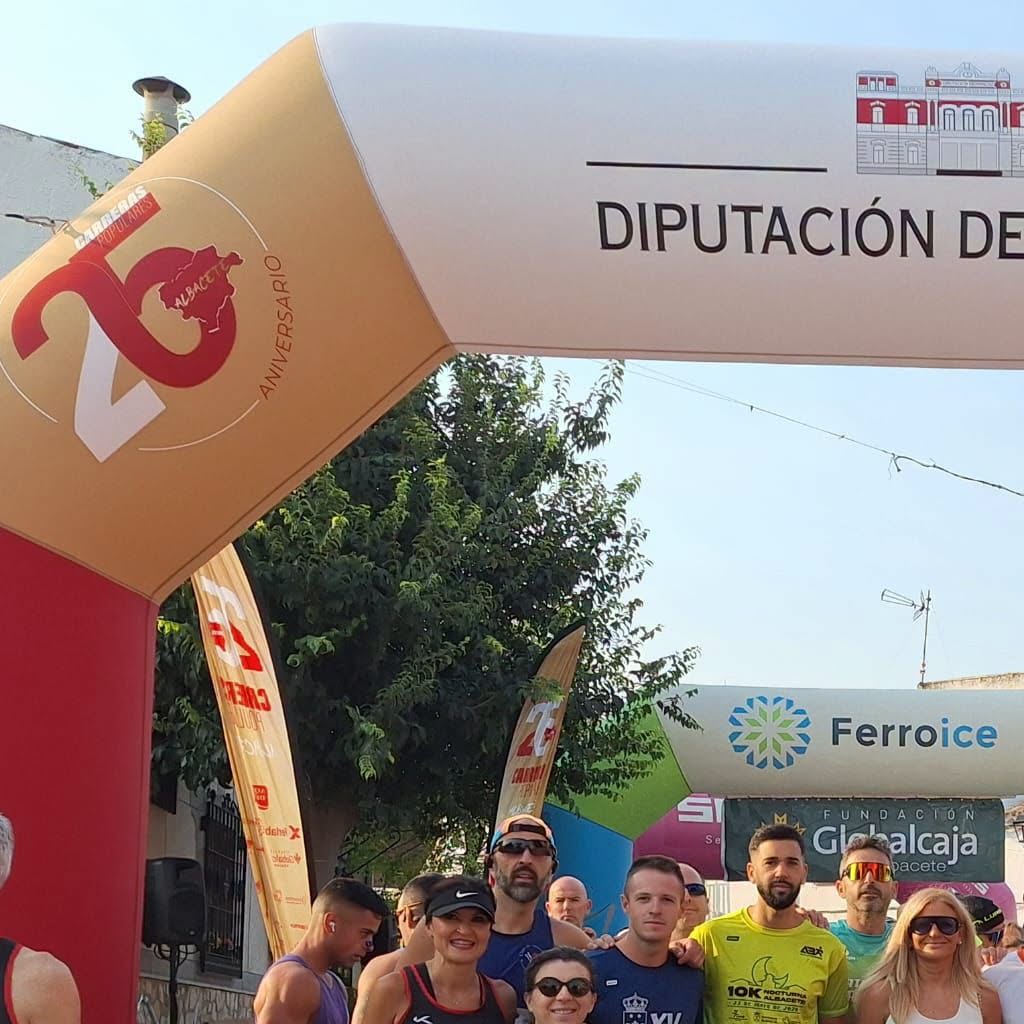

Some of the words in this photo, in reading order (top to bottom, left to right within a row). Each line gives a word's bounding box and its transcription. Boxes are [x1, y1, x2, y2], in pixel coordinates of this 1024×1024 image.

[598, 196, 936, 259] DIPUTACIÓN
[174, 260, 231, 309] ALBACETE
[260, 254, 294, 400] ANIVERSARIO
[831, 717, 998, 748] Ferroice
[823, 808, 975, 821] FUNDACIÓN
[728, 986, 762, 998] 10K
